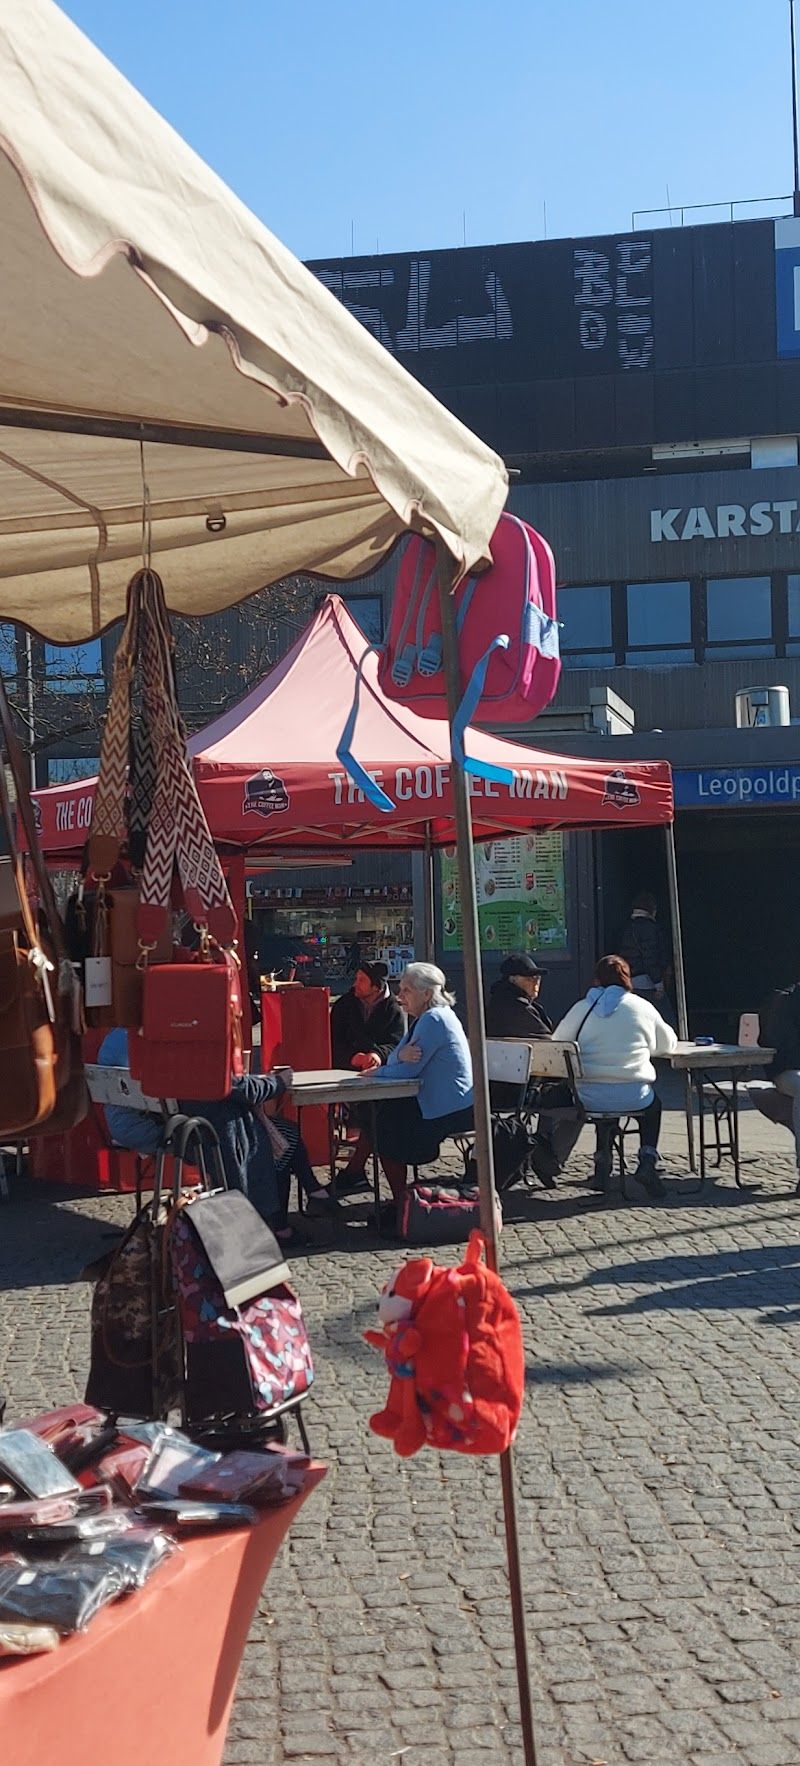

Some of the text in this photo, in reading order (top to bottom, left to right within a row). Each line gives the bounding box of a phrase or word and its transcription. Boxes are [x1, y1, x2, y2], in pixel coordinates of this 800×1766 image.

[650, 500, 800, 542] KARST
[396, 764, 500, 800] COFEE
[509, 769, 569, 800] MAN
[698, 769, 800, 800] Leopoldp
[56, 800, 76, 832] THE
